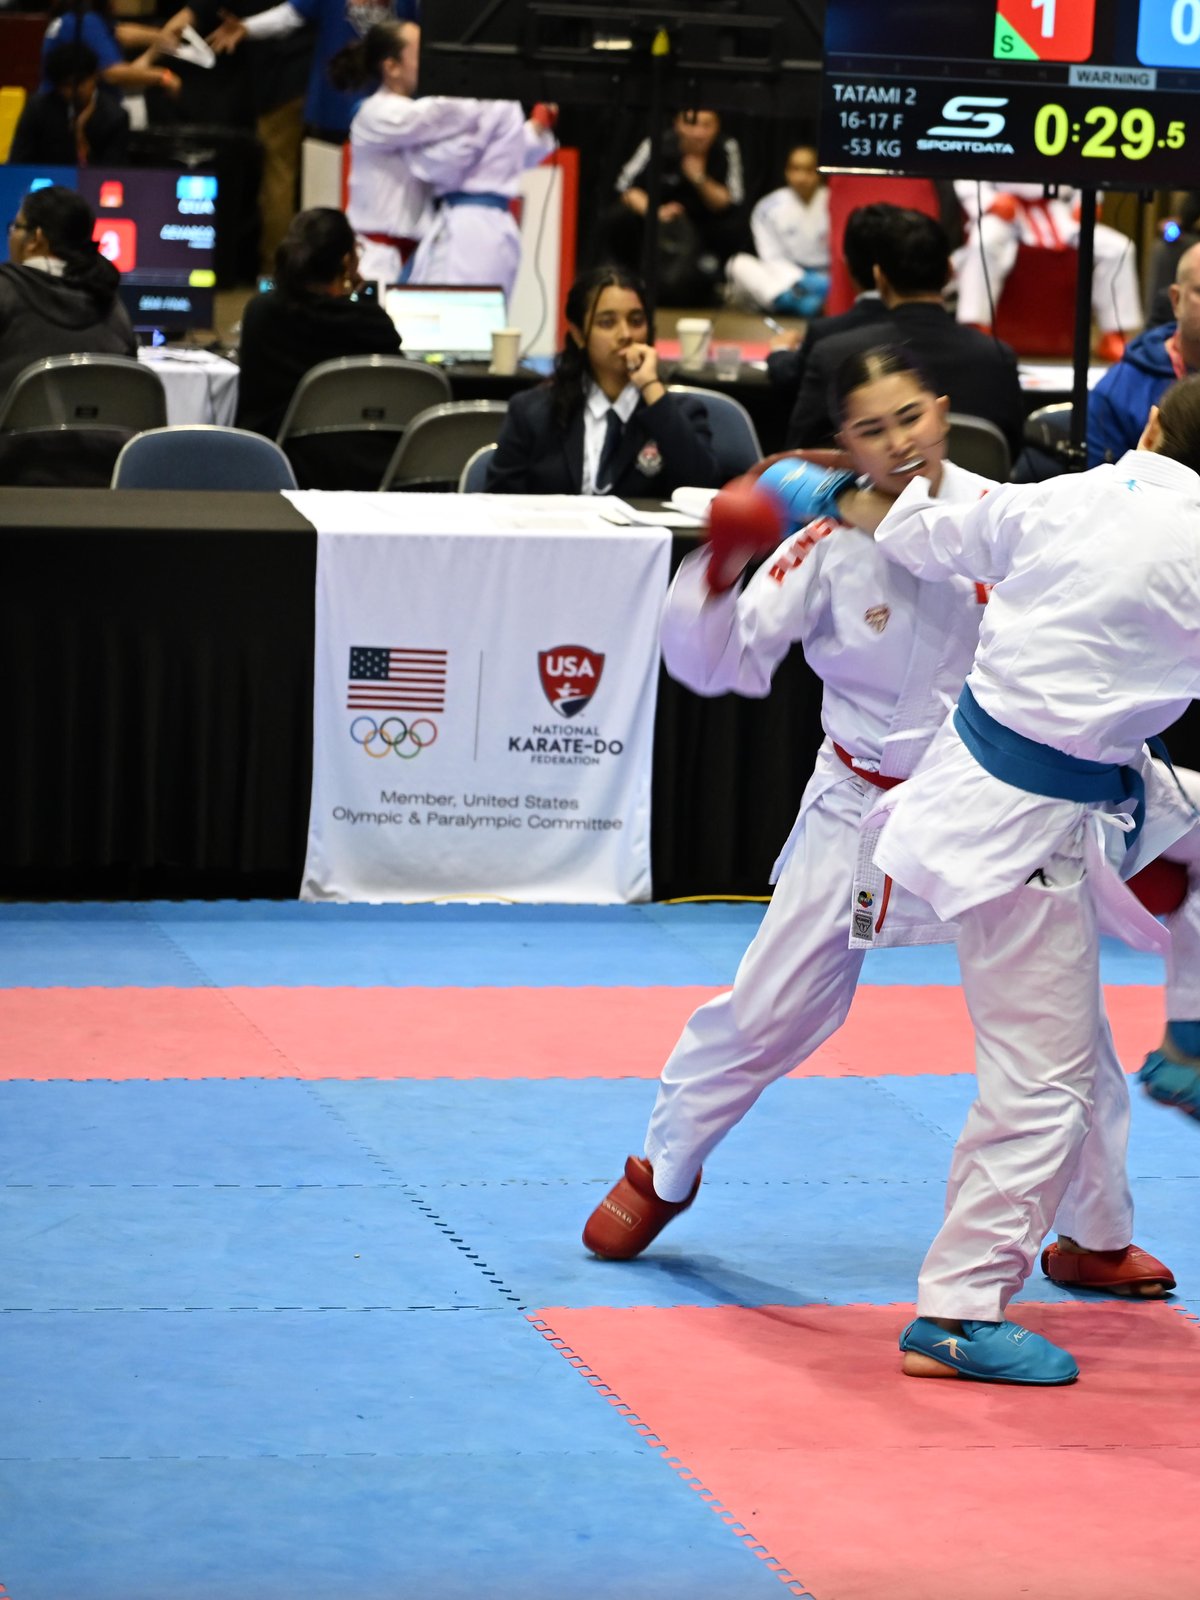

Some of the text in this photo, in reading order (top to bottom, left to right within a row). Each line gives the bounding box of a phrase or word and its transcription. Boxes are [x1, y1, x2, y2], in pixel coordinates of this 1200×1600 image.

[1031, 0, 1056, 38] 1
[999, 35, 1014, 53] S
[1076, 69, 1150, 87] WARNING
[832, 84, 917, 106] TATAMI 2
[839, 112, 904, 131] 16-17 F
[1034, 103, 1185, 160] 0:29.5
[842, 138, 902, 157] -53 KG
[916, 139, 1015, 154] SPORTDATA
[545, 655, 595, 678] USA
[532, 724, 600, 736] NATIONAL
[508, 736, 624, 756] KARATE-DO
[530, 754, 600, 766] FEDERATION
[380, 789, 580, 811] Member, United States
[332, 805, 624, 831] Olympic & Paralympic Committee
